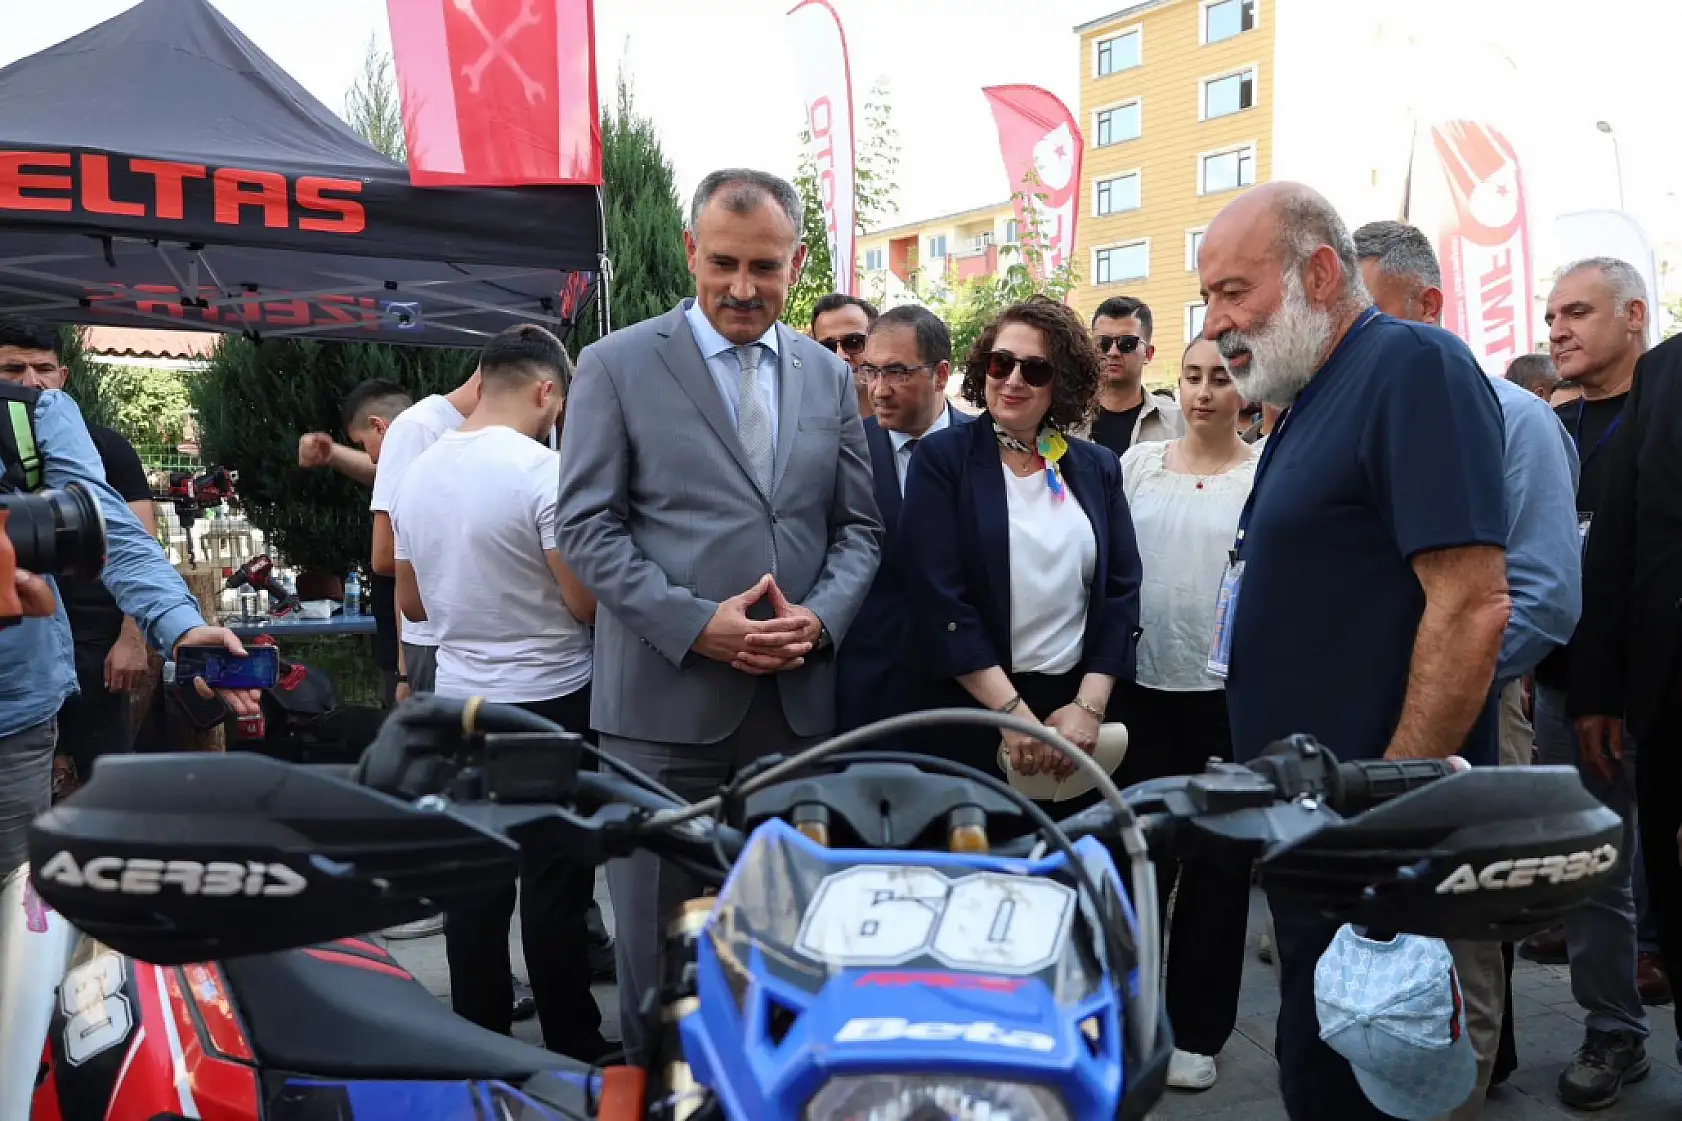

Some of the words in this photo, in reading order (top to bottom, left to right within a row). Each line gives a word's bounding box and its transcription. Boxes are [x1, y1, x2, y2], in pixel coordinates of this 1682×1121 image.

[0, 151, 366, 233] ELTAS
[794, 865, 1077, 974] 60
[834, 1017, 1056, 1051] Beta
